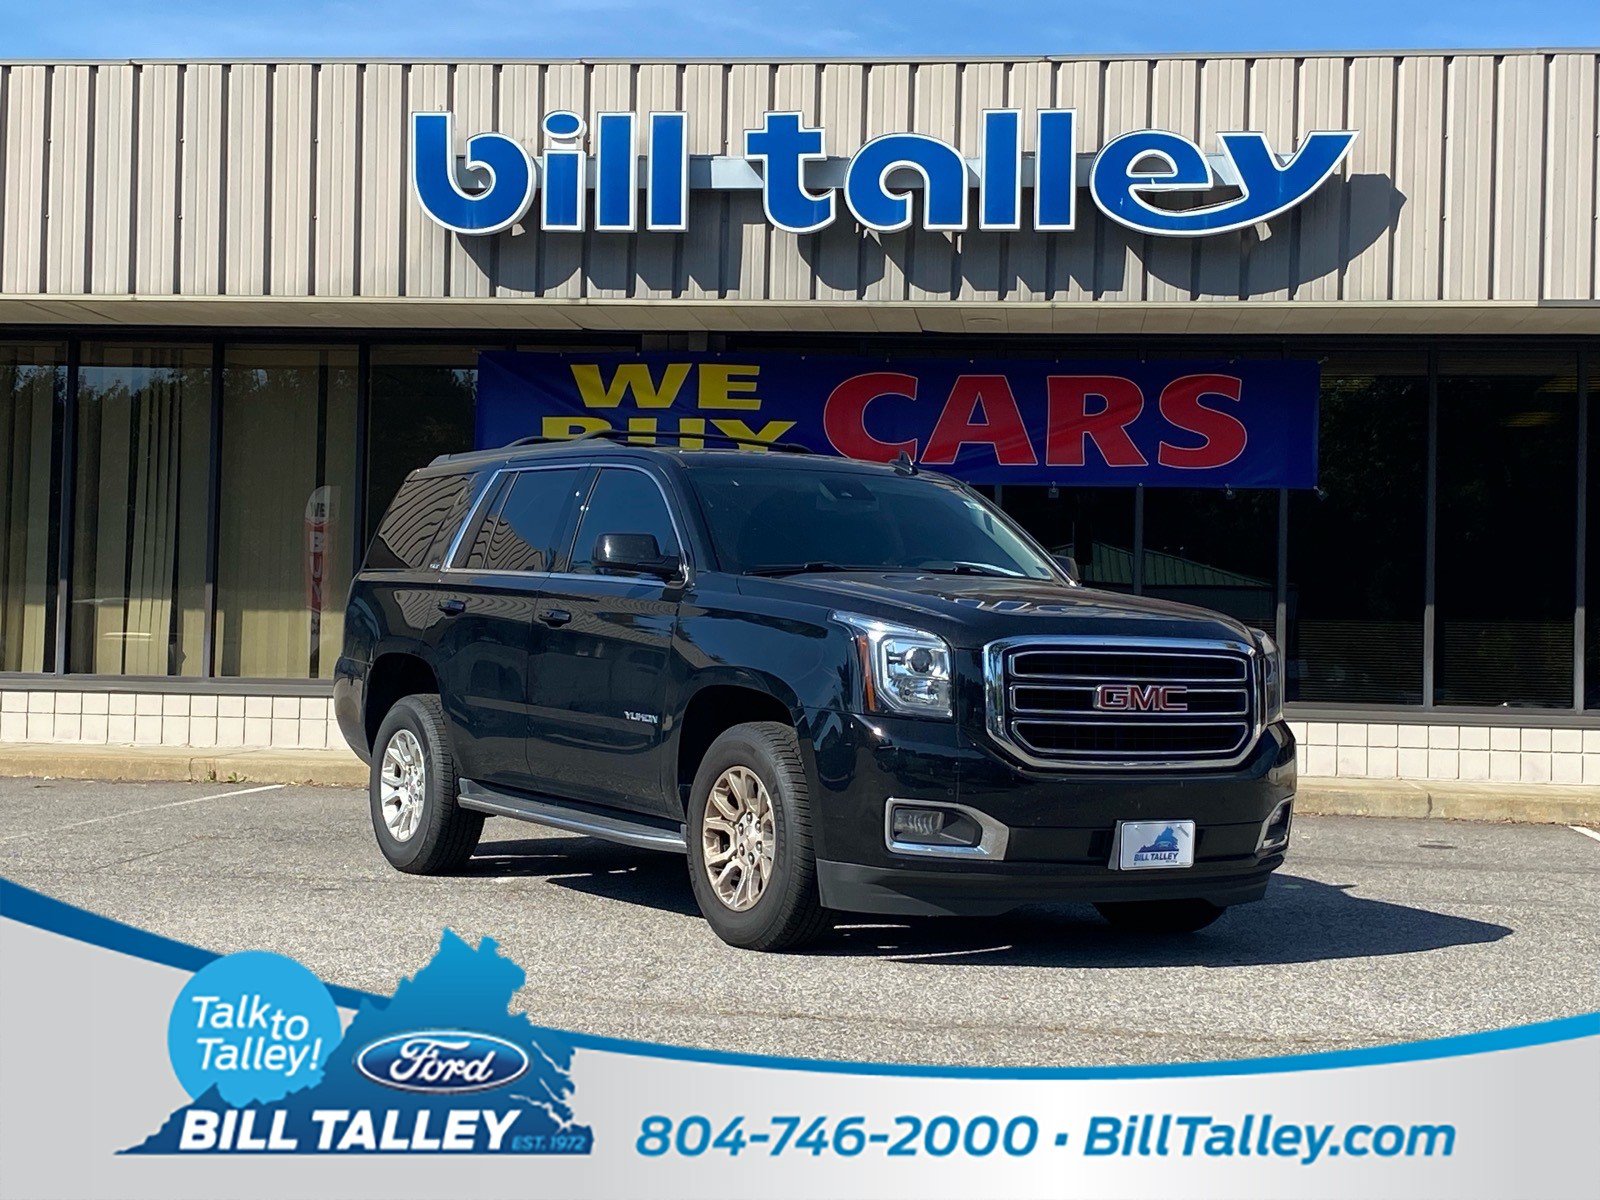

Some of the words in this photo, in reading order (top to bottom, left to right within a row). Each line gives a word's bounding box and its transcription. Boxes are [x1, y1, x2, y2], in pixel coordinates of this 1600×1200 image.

[411, 110, 689, 234] bill
[743, 107, 1358, 236] talley
[570, 363, 761, 410] WE
[823, 372, 1248, 469] CARS
[1096, 684, 1188, 711] GMC
[623, 710, 659, 724] YUKON
[1133, 853, 1150, 862] BILL
[1150, 852, 1179, 861] TALLEY
